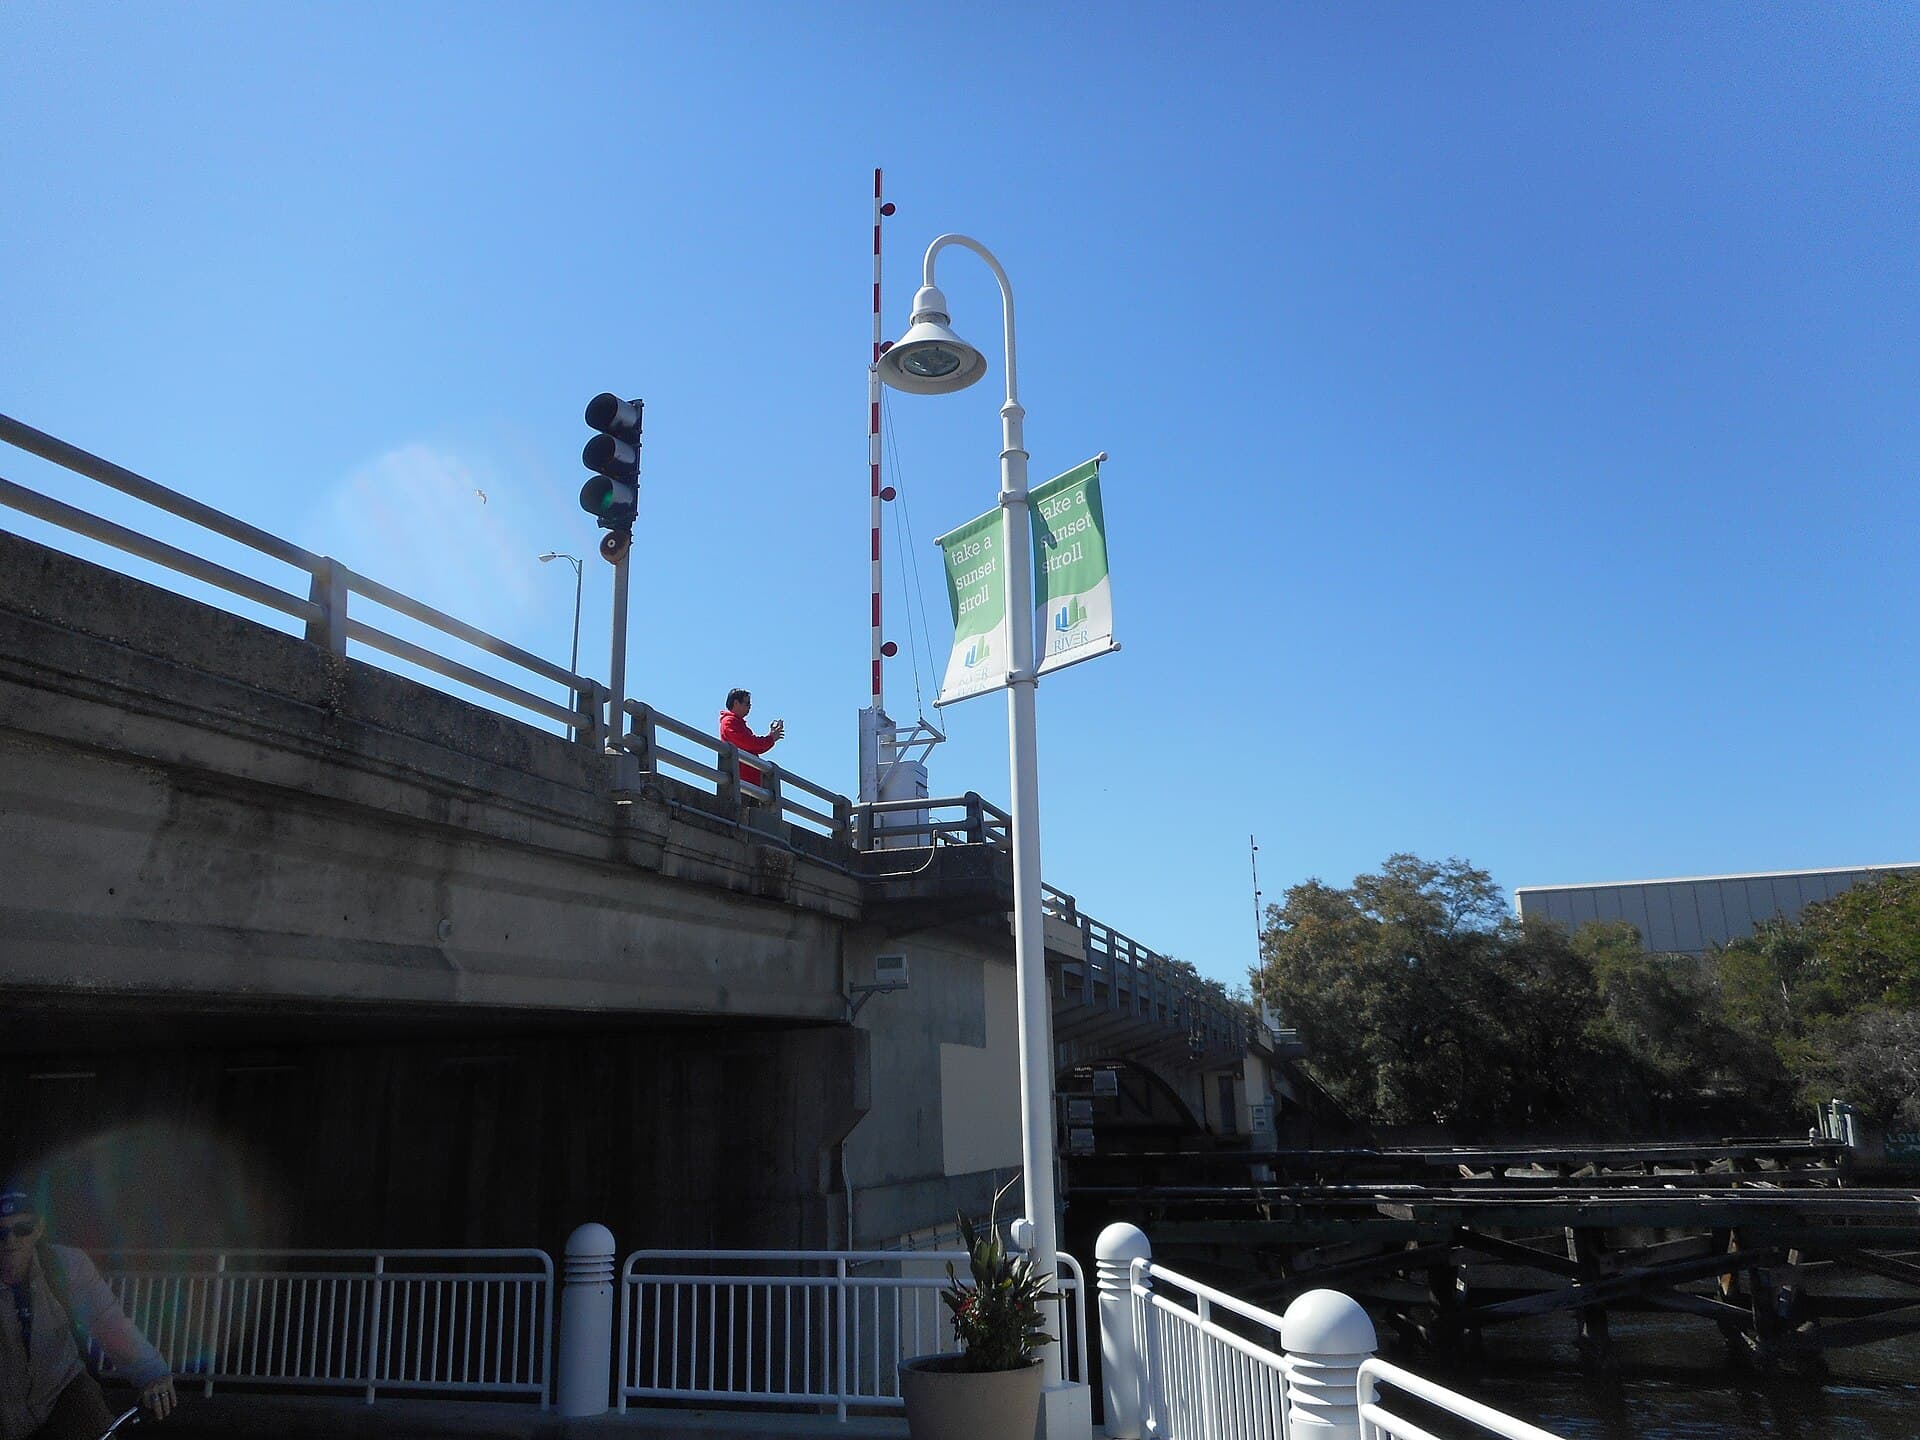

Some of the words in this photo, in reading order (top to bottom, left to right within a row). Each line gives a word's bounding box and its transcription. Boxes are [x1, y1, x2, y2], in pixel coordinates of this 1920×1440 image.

[1075, 490, 1086, 504] a
[1040, 511, 1093, 547] sunset
[951, 544, 981, 566] take
[983, 536, 992, 550] a
[1042, 541, 1083, 574] stroll
[956, 555, 996, 591] sunset
[960, 584, 989, 616] stroll
[1054, 630, 1089, 652] RIVER
